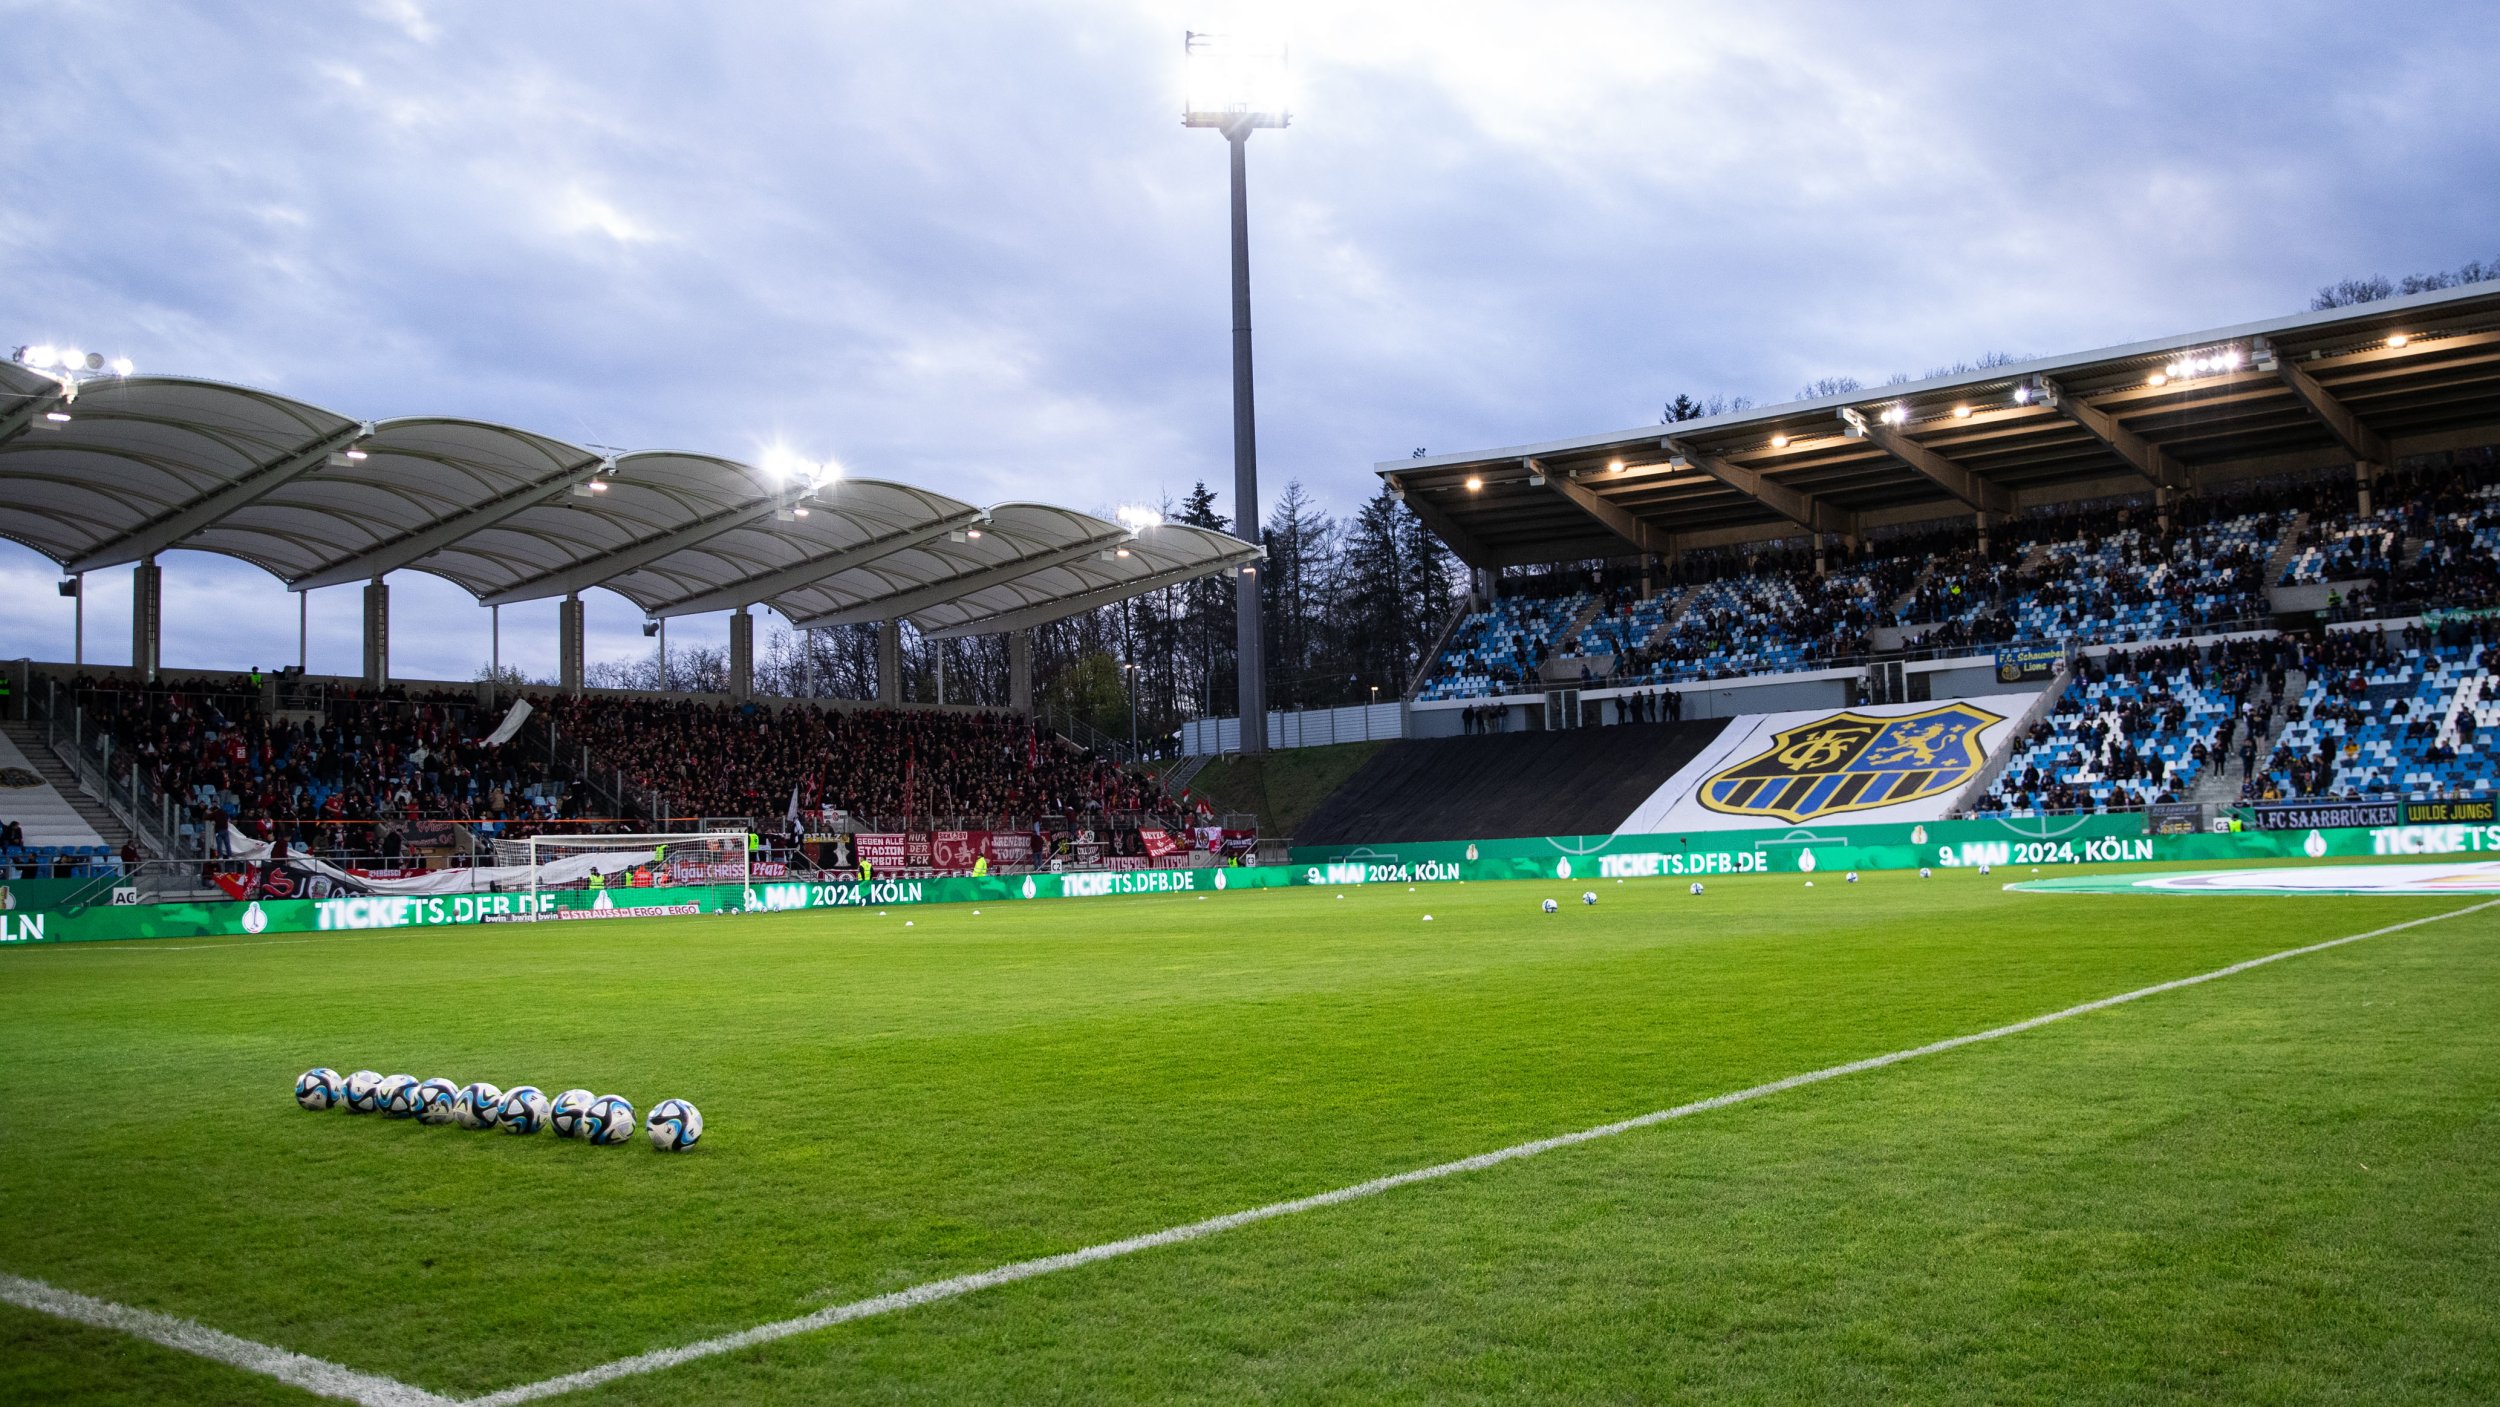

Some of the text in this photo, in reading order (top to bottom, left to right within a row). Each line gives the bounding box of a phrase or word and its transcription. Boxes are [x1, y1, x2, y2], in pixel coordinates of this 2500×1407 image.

[2017, 649, 2070, 662] Schaumber
[2257, 804, 2397, 829] 1.FC SAARBRÜCKEN
[2408, 802, 2493, 822] WILDE JUNGS
[856, 837, 905, 846] GEGEN ALLE
[909, 833, 927, 842] NUR
[857, 845, 905, 856] STADION
[909, 844, 928, 853] DER
[1938, 836, 2153, 866] 9. MAI 2024, KÖLN
[858, 856, 905, 866] ERBOTE
[910, 855, 930, 865] FCK
[1052, 862, 1061, 871] C2
[1599, 851, 1768, 877] TICKETS.DFB.DE
[669, 862, 704, 884] llgäu
[752, 862, 786, 876] Pfalz
[1307, 860, 1460, 884] 9. MAI 2024, KÖLN
[1061, 871, 1194, 897] TICKETS.DFB.DE
[764, 886, 808, 909] MAI
[811, 884, 867, 907] 2024,
[871, 879, 922, 903] KÖLN
[315, 894, 556, 930] TICKETS.DFBDE
[485, 914, 507, 923] bwin
[538, 911, 559, 920] bwin
[571, 905, 697, 920] STRAUSS ERGO ERGO
